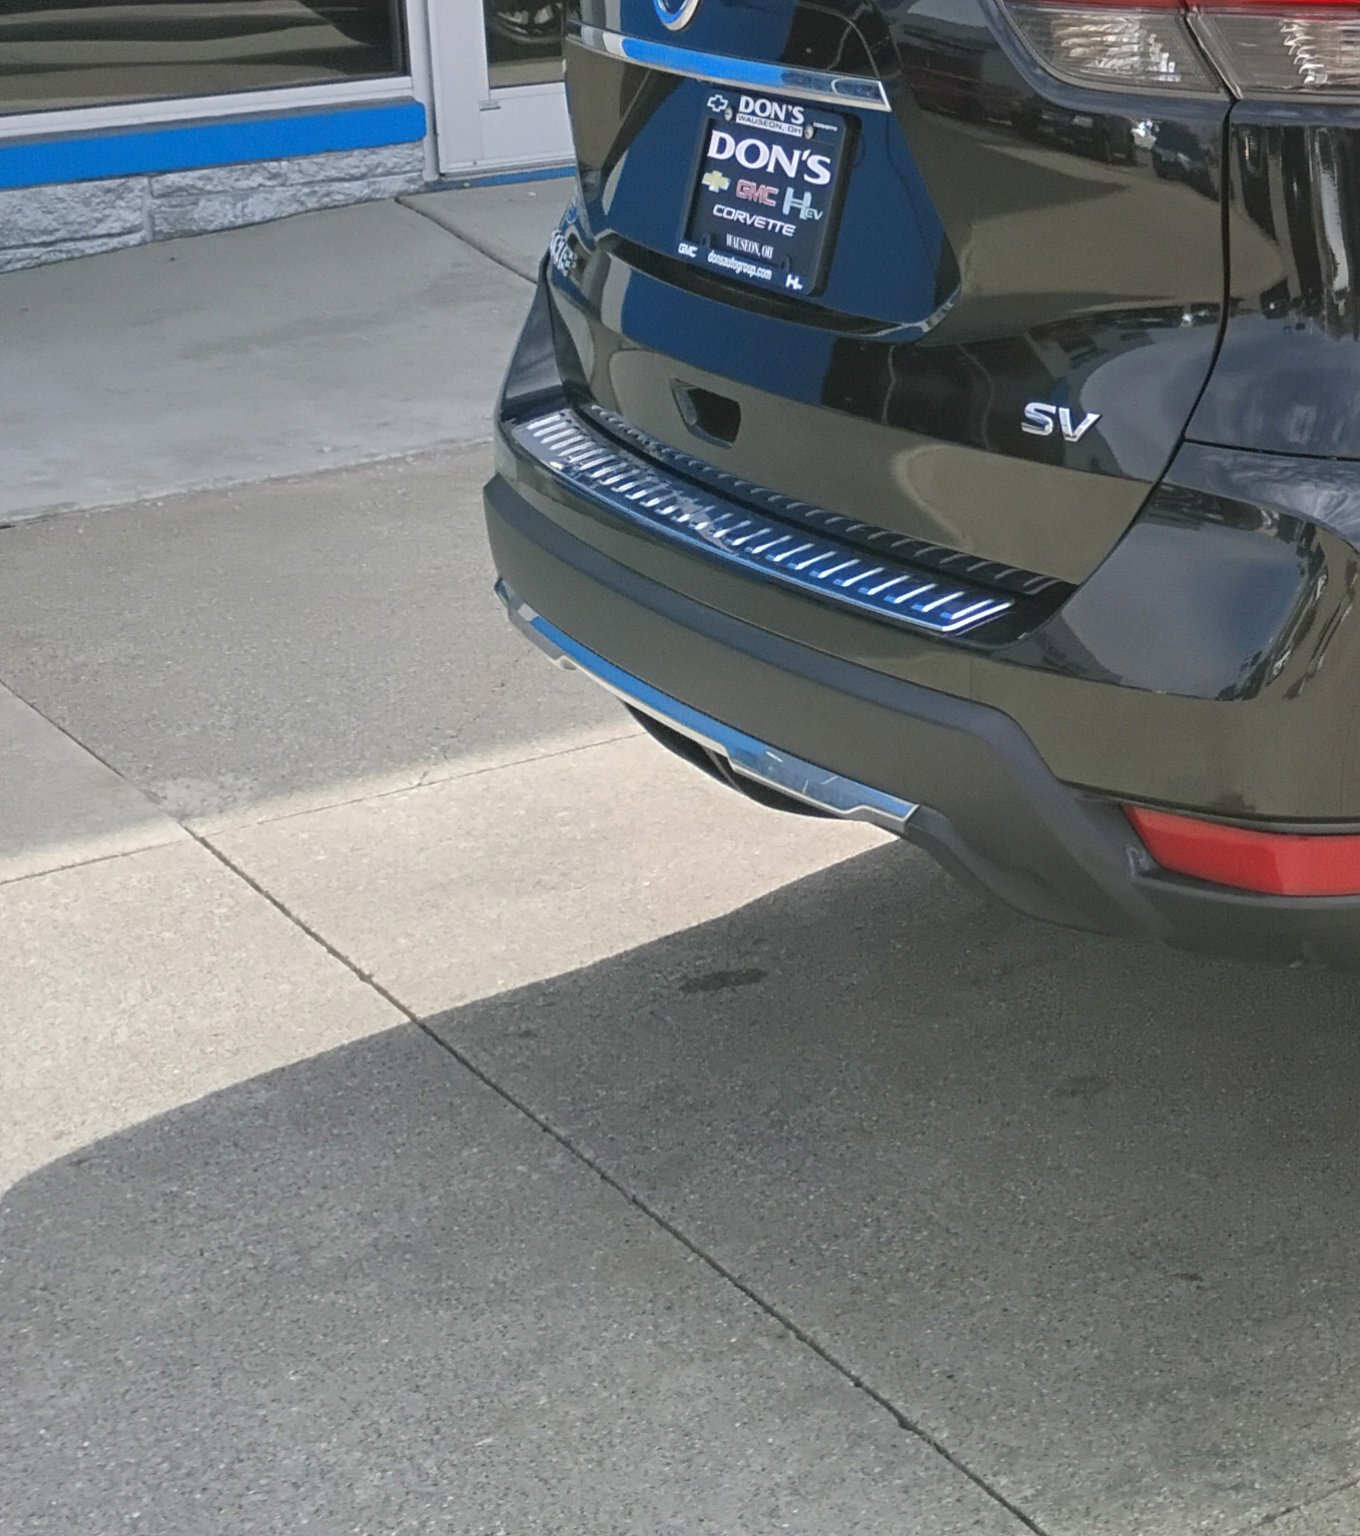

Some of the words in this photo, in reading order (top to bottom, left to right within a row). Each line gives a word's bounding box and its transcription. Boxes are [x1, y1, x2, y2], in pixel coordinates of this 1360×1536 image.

[739, 95, 804, 124] DON'S
[738, 116, 785, 131] WAUSEON,
[787, 125, 802, 135] OH
[707, 129, 831, 185] DON'S
[736, 179, 779, 207] GMC
[713, 204, 796, 237] CORVETTE
[678, 242, 698, 258] GMC
[1021, 402, 1101, 442] SV
